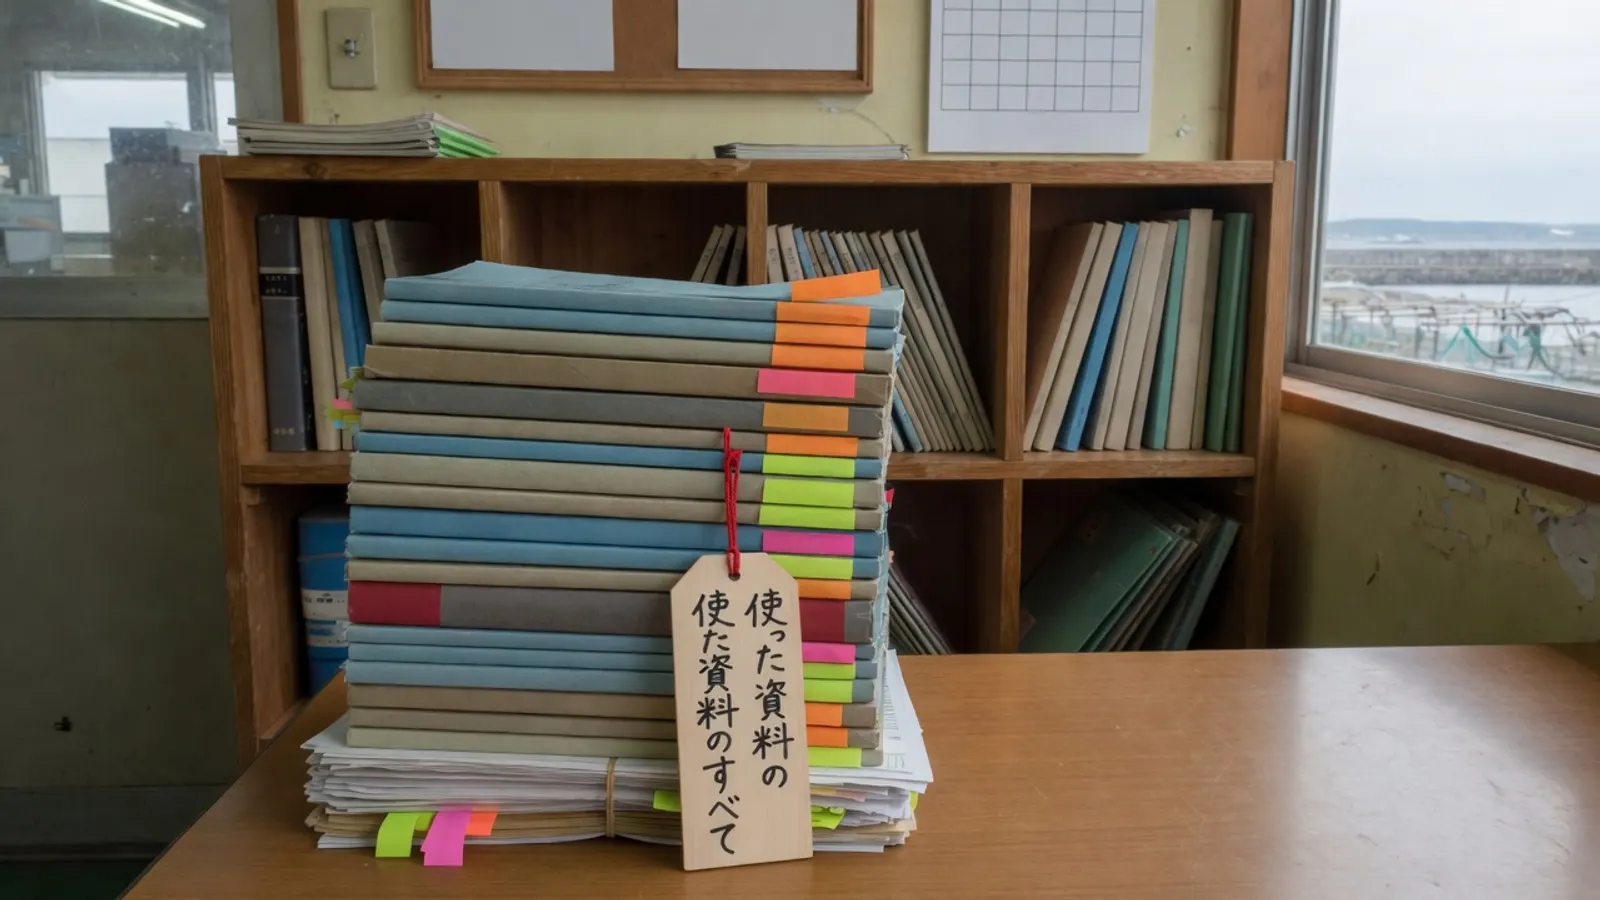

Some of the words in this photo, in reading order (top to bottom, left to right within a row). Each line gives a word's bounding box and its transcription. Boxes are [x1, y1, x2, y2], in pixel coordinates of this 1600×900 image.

[691, 589, 740, 855] 使た資料のすべて
[744, 588, 795, 788] 使った資料の
